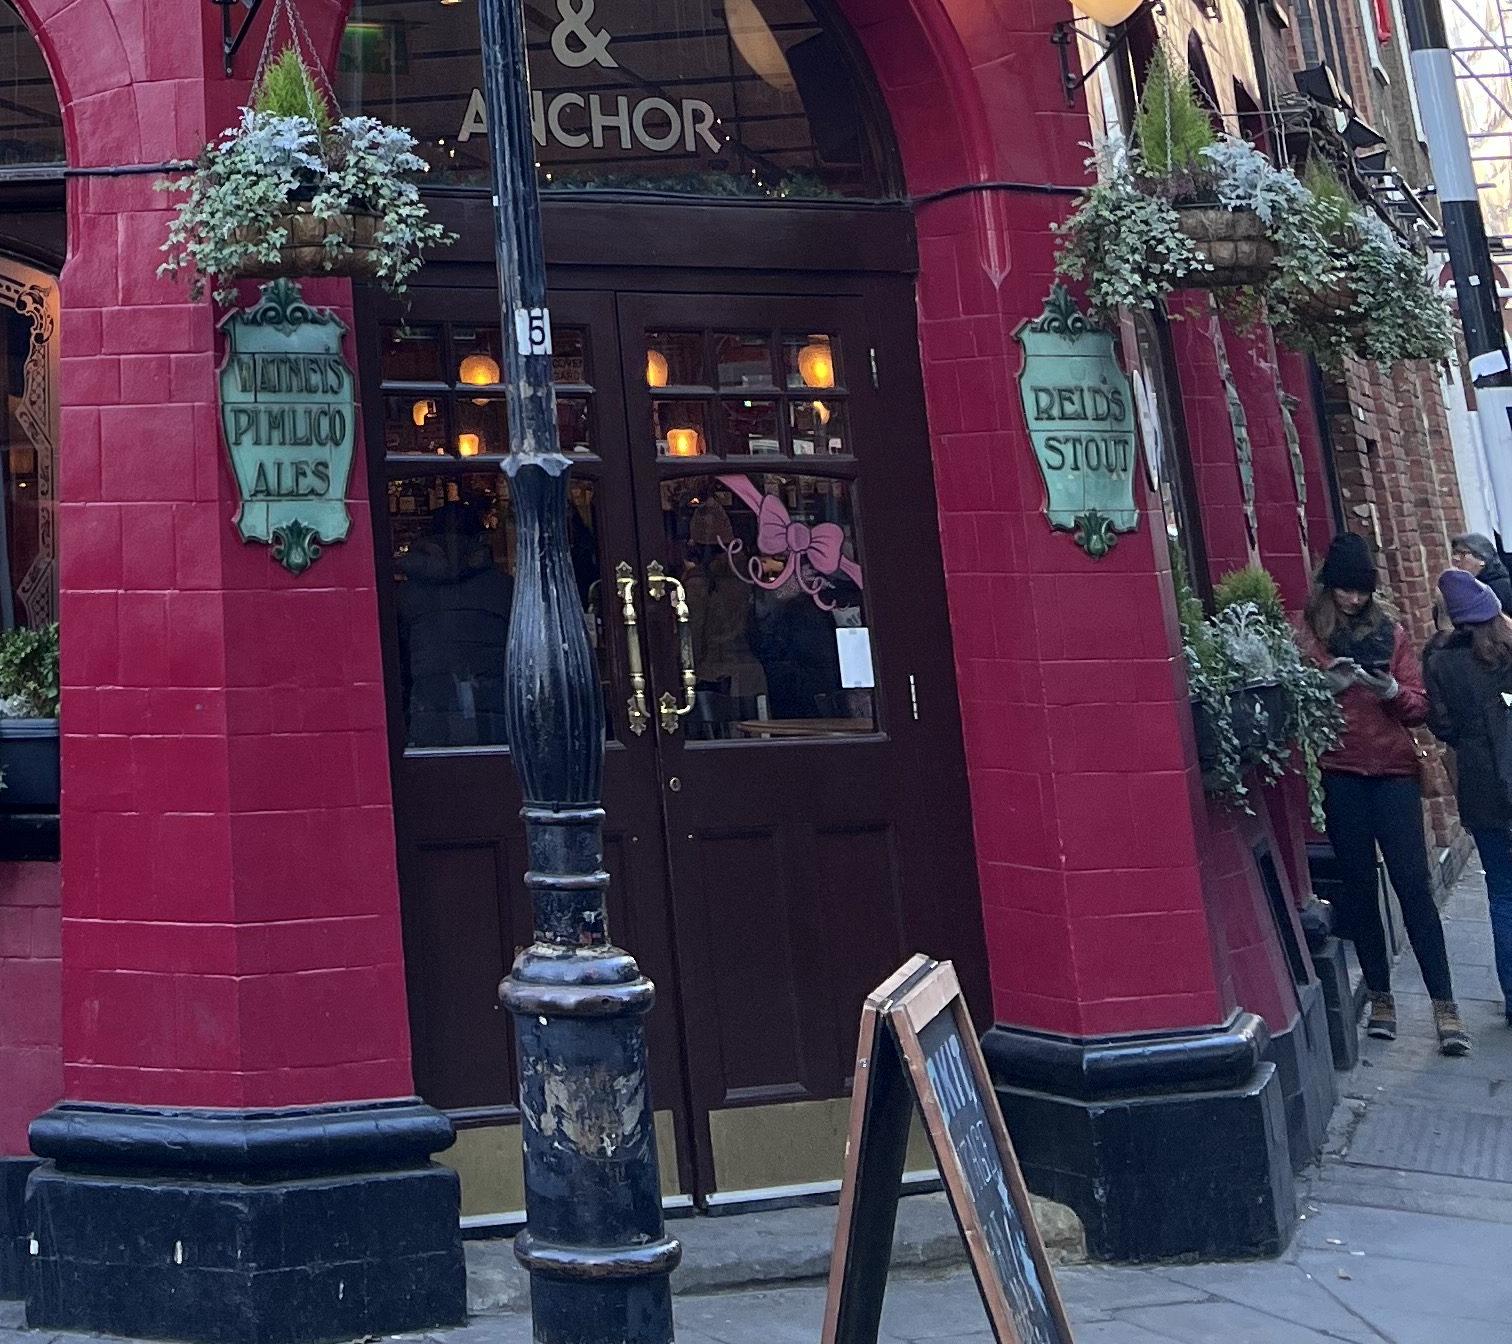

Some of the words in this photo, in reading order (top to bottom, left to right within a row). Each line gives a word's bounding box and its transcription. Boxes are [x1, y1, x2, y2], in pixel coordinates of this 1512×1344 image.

[230, 406, 347, 447] PIMLICO
[1044, 434, 1129, 473] STOUT
[249, 458, 331, 498] ALES
